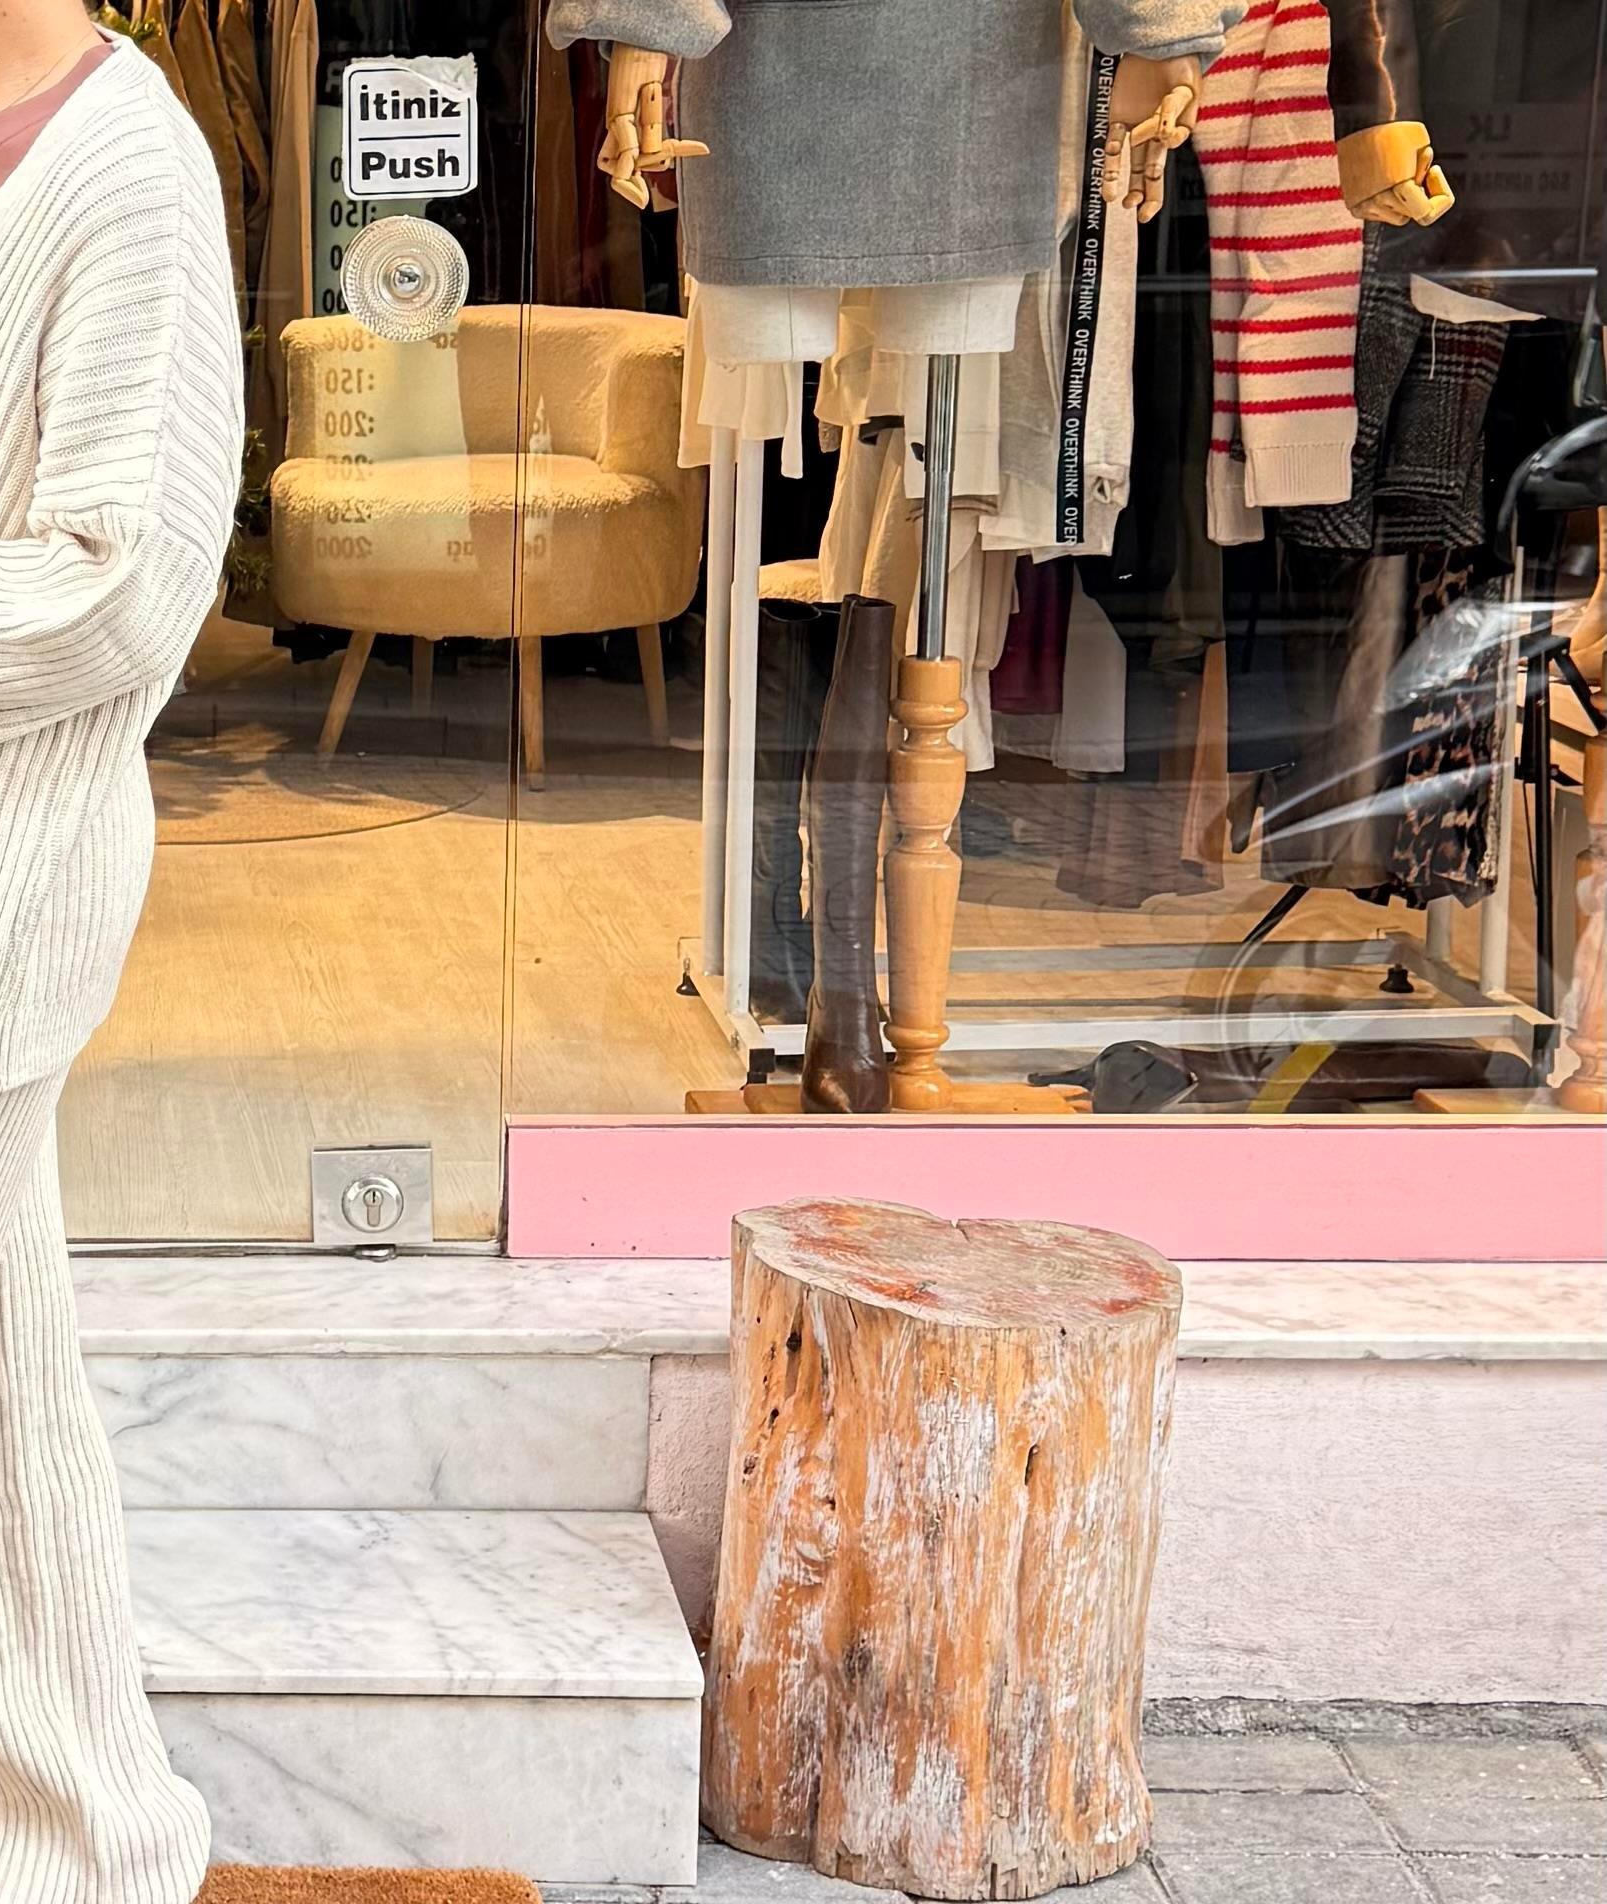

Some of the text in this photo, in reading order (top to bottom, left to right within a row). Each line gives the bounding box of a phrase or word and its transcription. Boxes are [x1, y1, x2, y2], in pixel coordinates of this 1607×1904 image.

[360, 84, 461, 121] İtiniz
[1092, 56, 1115, 139] OVERTHINK
[361, 148, 460, 180] Push
[1086, 147, 1106, 230] OVERTHINK
[1077, 238, 1099, 321] OVERTHINK
[1066, 328, 1090, 409] OVERTHINK
[1063, 418, 1080, 498] OVERTHINK
